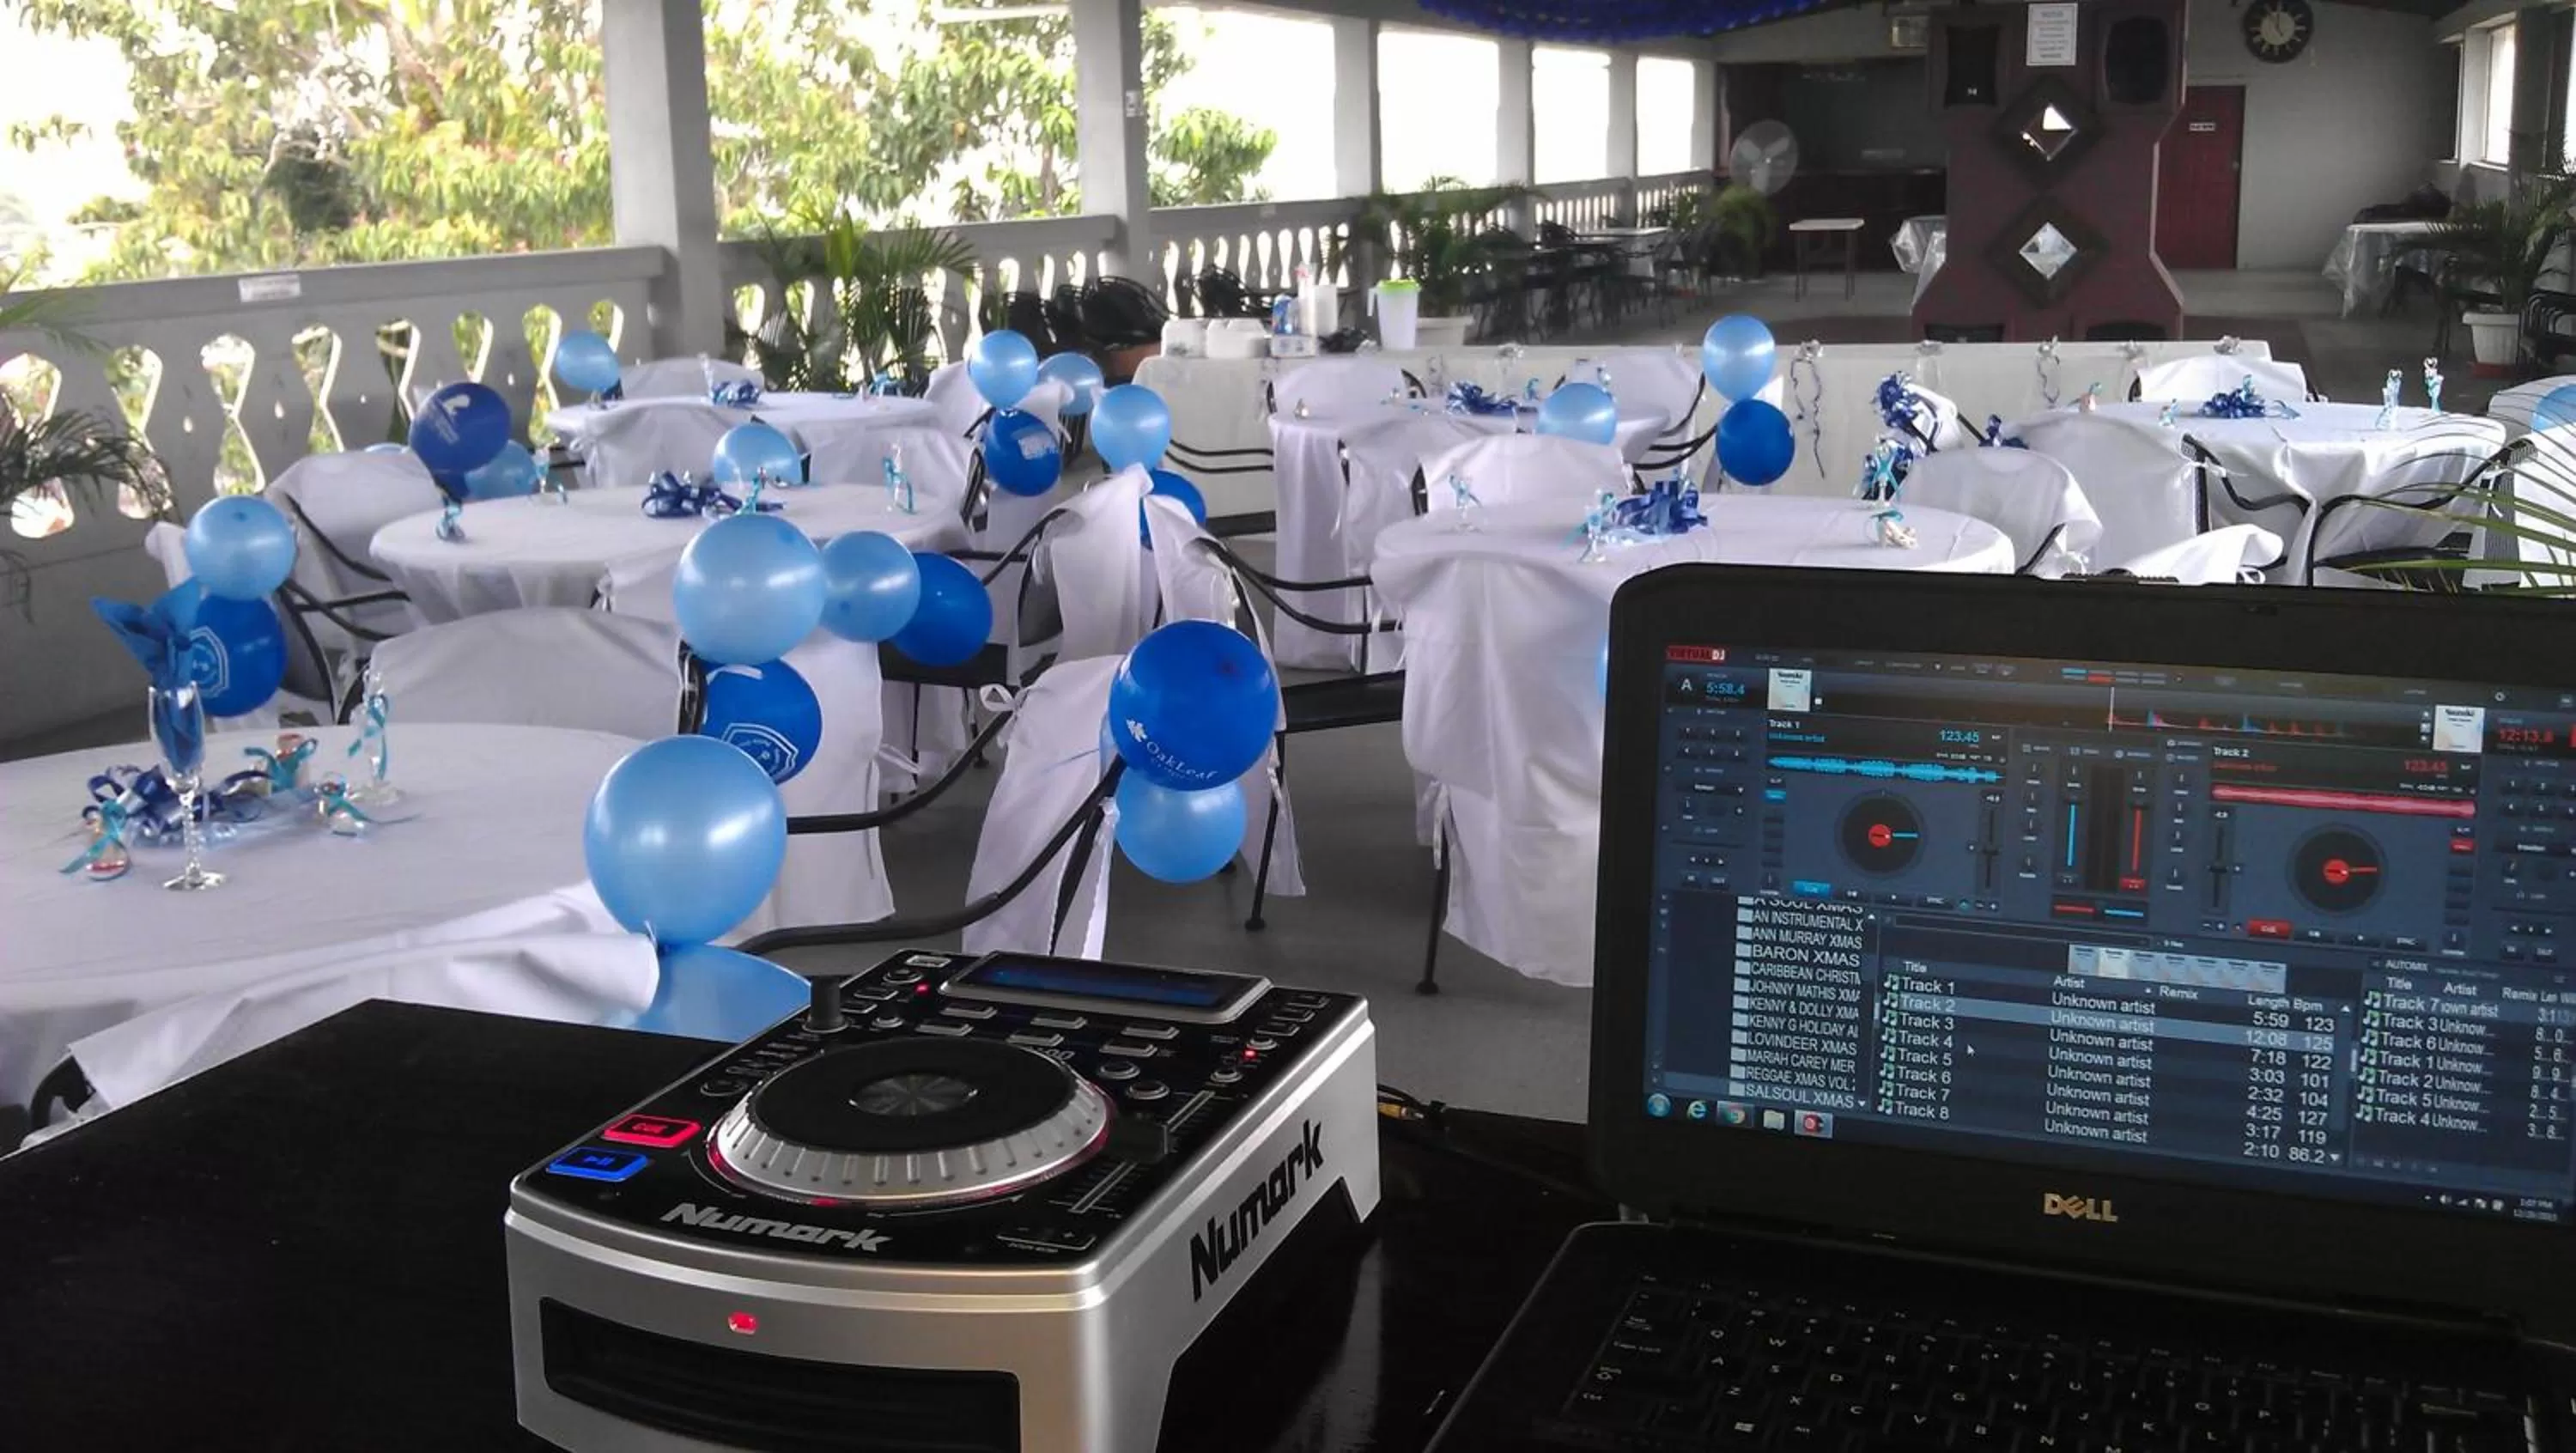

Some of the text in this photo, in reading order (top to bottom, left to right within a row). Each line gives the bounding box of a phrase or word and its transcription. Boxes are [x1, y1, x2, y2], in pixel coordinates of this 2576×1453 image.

[1680, 678, 1692, 690] A
[1769, 720, 1792, 728] Track
[1147, 741, 1218, 780] OakLeaf
[2213, 746, 2249, 757] Track 2
[1753, 911, 1864, 932] AN INSTRUMENTAL X
[1752, 929, 1862, 950] ANN MURRAY XMAS
[1752, 944, 1860, 967] BARON XMAS
[1751, 963, 1813, 980] CARIBBEAN
[1903, 961, 1927, 973] Title
[2385, 959, 2429, 973] AUTOMIX
[1750, 981, 1794, 997] JOHNNY
[1796, 986, 1837, 1001] MATHIS
[1903, 976, 1955, 995] Track 1
[2054, 976, 2085, 989] Artist
[2386, 976, 2412, 990] Title
[2443, 982, 2477, 996] Artist
[2160, 986, 2198, 1000] Remix
[2248, 994, 2289, 1010] Length
[2502, 987, 2537, 1001] Remix
[1748, 999, 1786, 1014] KENNY
[1789, 1001, 1796, 1014] &
[1798, 1003, 1833, 1018] DOLLY
[1902, 994, 1955, 1012] Track 2
[2052, 991, 2156, 1015] Unknown artist
[2293, 999, 2323, 1012] Bpm
[2383, 994, 2439, 1013] Track 7
[2470, 1005, 2499, 1018] artist
[1748, 1018, 1786, 1031] KENNY
[1788, 1019, 1796, 1031] G
[1799, 1021, 1845, 1037] HOLIDAY
[1900, 1012, 1954, 1030] Track 3
[2051, 1010, 2154, 1034] Unknown artist
[2253, 1012, 2289, 1029] 5:59
[2306, 1016, 2335, 1032] 123
[2382, 1012, 2438, 1031] Track 3
[1748, 1033, 1857, 1055] LOVINDEER XMAS
[1899, 1030, 1953, 1049] Track 4
[2050, 1029, 2154, 1052] Unknown artist
[2305, 1035, 2333, 1051] 125
[2381, 1031, 2436, 1050] Track 6
[1746, 1051, 1856, 1073] MARIAH CAREY MER
[1899, 1048, 1952, 1066] Track 5
[2049, 1047, 2153, 1070] Unknown artist
[2251, 1049, 2287, 1065] 7:18
[2302, 1054, 2332, 1070] 122
[2379, 1050, 2434, 1069] Track 1
[1746, 1068, 1848, 1090] REGGAE XMAS VOL
[1897, 1066, 1951, 1084] Track 6
[2048, 1065, 2151, 1088] Unknown artist
[2249, 1067, 2285, 1085] 3:03
[2300, 1073, 2329, 1088] 101
[2378, 1069, 2433, 1088] Track 2
[1745, 1086, 1854, 1109] SALSOUL XMAS
[1896, 1083, 1950, 1102] Track 7
[2046, 1083, 2150, 1107] Unknown artist
[2247, 1086, 2284, 1103] 2:32
[2300, 1091, 2329, 1107] 104
[2377, 1089, 2432, 1108] Track 5
[1896, 1101, 1949, 1119] Track 8
[2046, 1101, 2149, 1126] Unknown artist
[2246, 1105, 2282, 1122] 4:25
[2298, 1110, 2328, 1127] 127
[2375, 1107, 2430, 1126] Track 4
[2044, 1119, 2148, 1143] Unknown artist
[2245, 1124, 2281, 1141] 3:17
[2298, 1128, 2326, 1145] 119
[2243, 1141, 2280, 1158] 2:10
[2288, 1146, 2324, 1164] 86.2
[1189, 1119, 1325, 1302] Numark
[2042, 1193, 2119, 1223] DELL
[659, 1201, 893, 1252] Numark
[1768, 1336, 1787, 1347] W
[1829, 1373, 1844, 1384] D
[2069, 1381, 2082, 1391] U
[1788, 1395, 1803, 1406] X
[1849, 1405, 1865, 1415] C
[1913, 1414, 1929, 1425] V
[2039, 1434, 2056, 1446] N
